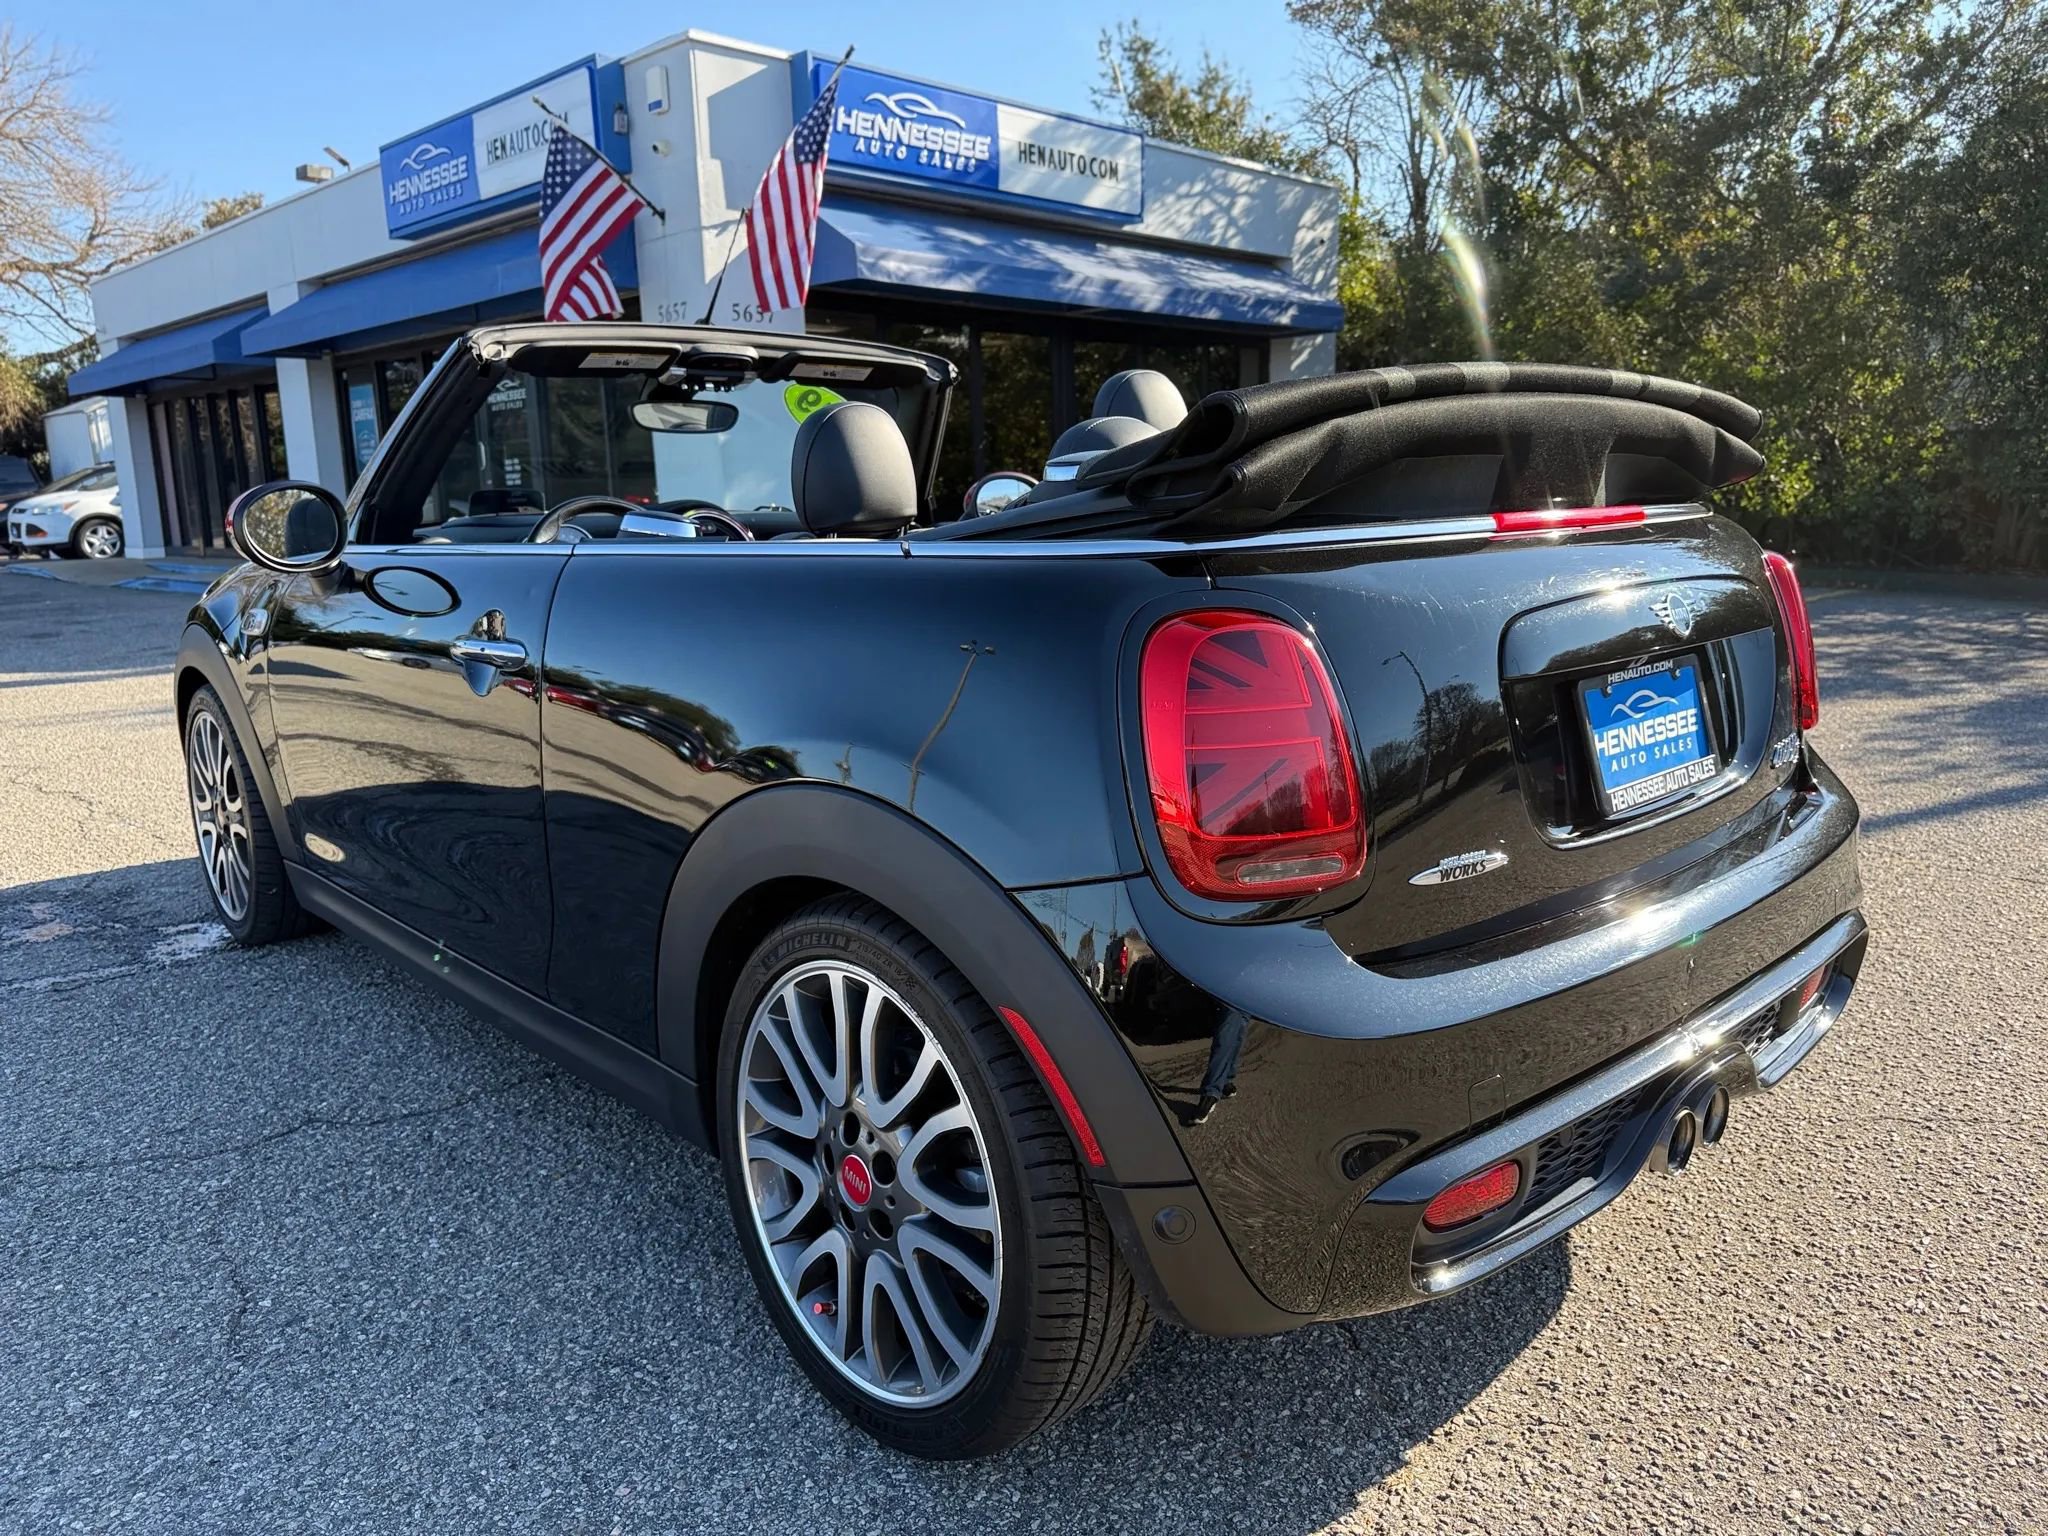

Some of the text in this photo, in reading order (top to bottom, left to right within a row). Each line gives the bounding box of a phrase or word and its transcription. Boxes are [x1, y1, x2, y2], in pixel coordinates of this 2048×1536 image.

[486, 112, 569, 165] HENAUTO.C
[836, 107, 992, 161] HENNESSEE
[855, 137, 977, 174] AUTO SALES
[388, 155, 468, 205] HENNESSEE
[399, 184, 463, 215] AUTO SALES
[658, 302, 687, 323] 5657
[1608, 659, 1674, 684] HENAUTO.COM
[1594, 708, 1699, 758] HENNESSEE
[1611, 737, 1693, 773] AUTO SALES
[1611, 758, 1716, 812] HENNESSEE AUTO SALES
[1440, 860, 1487, 882] WORKS
[778, 933, 847, 955] MICHELIN
[844, 1166, 867, 1195] MINI
